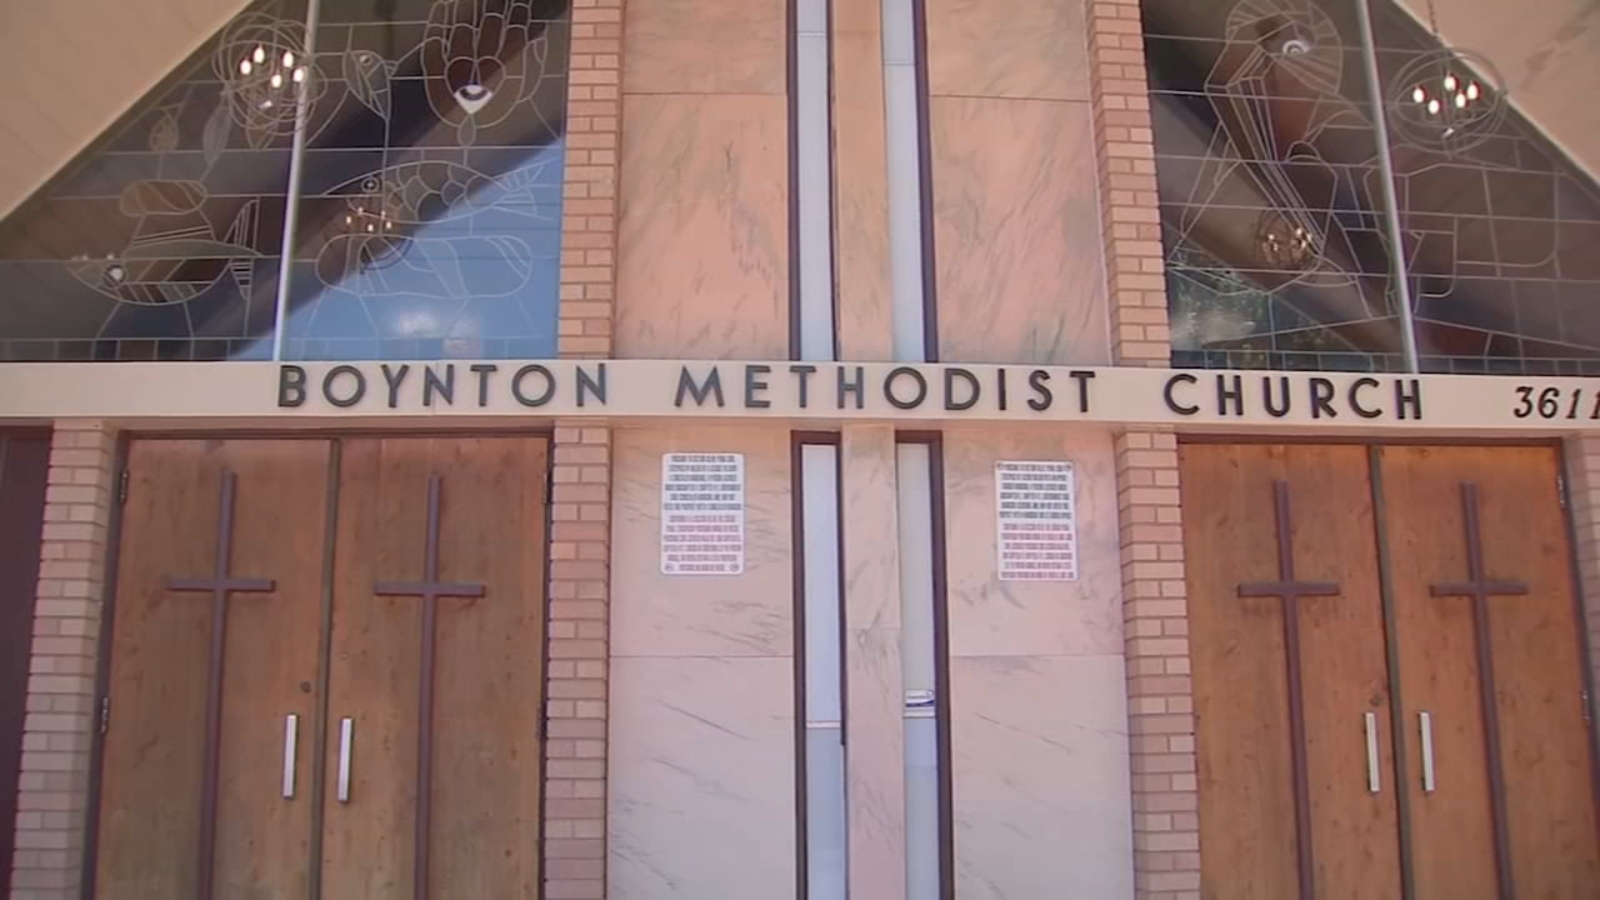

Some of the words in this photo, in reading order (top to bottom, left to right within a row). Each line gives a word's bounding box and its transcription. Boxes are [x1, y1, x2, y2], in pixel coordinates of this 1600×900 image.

[277, 363, 608, 408] BOYNTON
[674, 364, 1096, 413] METHODIST
[1163, 373, 1422, 420] CHURCH
[1513, 385, 1600, 420] 3611
